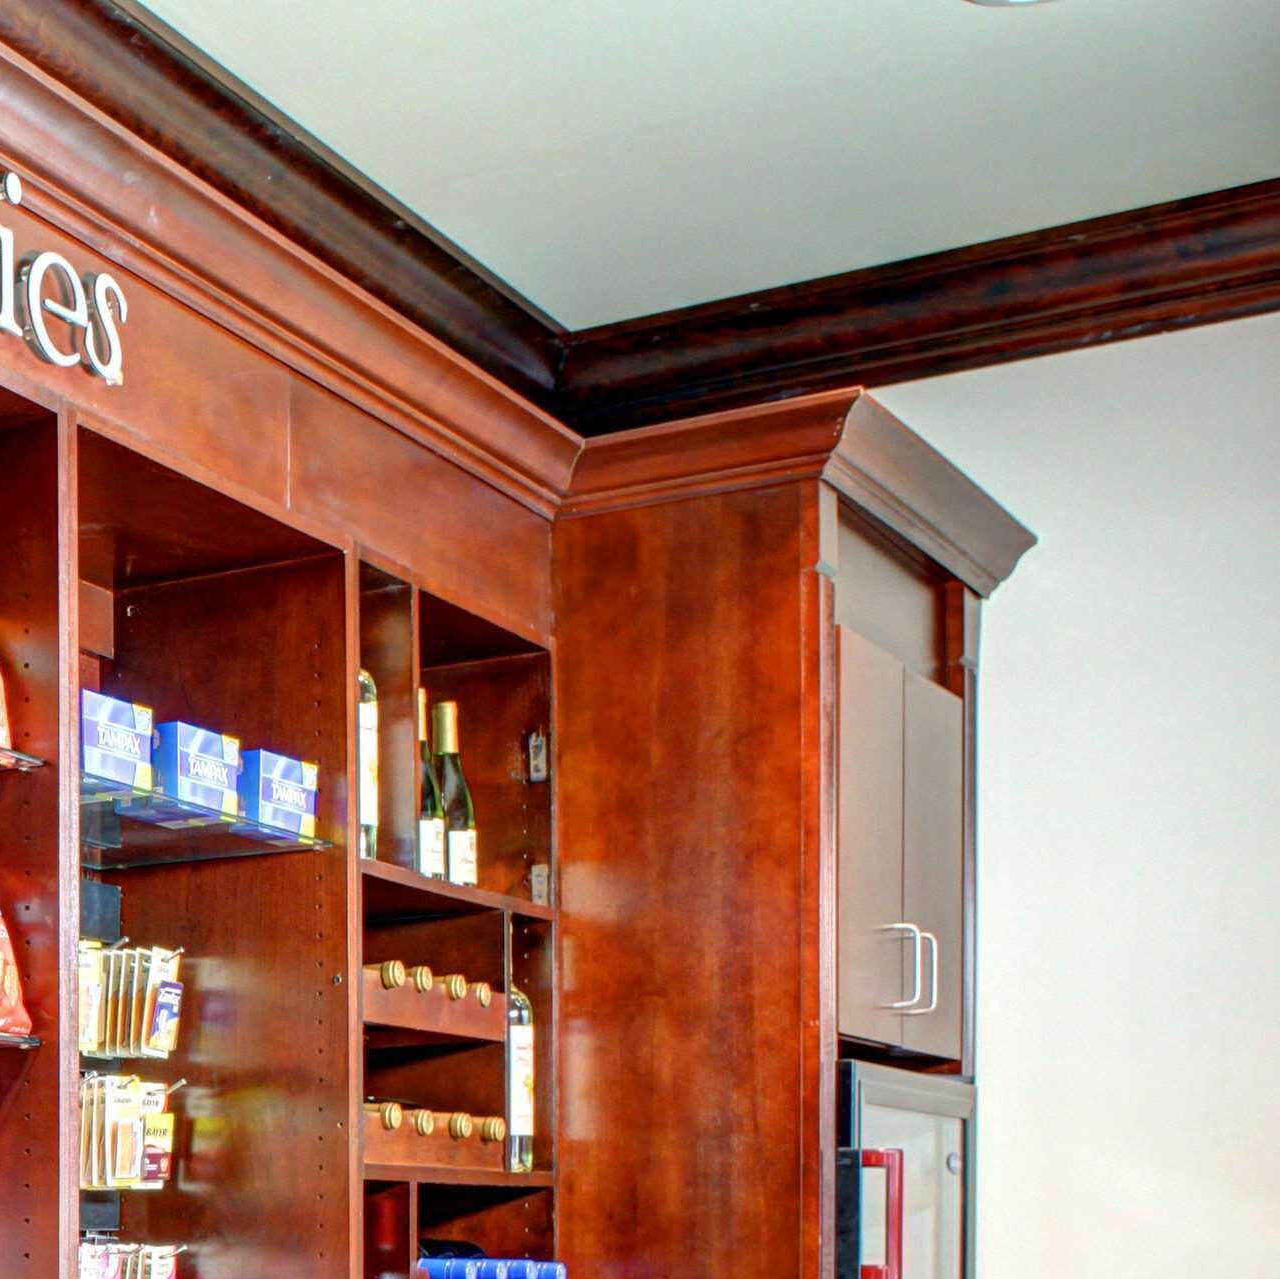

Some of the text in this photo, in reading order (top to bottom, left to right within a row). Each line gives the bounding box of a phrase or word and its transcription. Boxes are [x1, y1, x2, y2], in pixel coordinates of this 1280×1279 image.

[96, 725, 141, 756] TAMPAX
[188, 756, 229, 785] TAMPAX
[271, 784, 308, 811] TAMPAX
